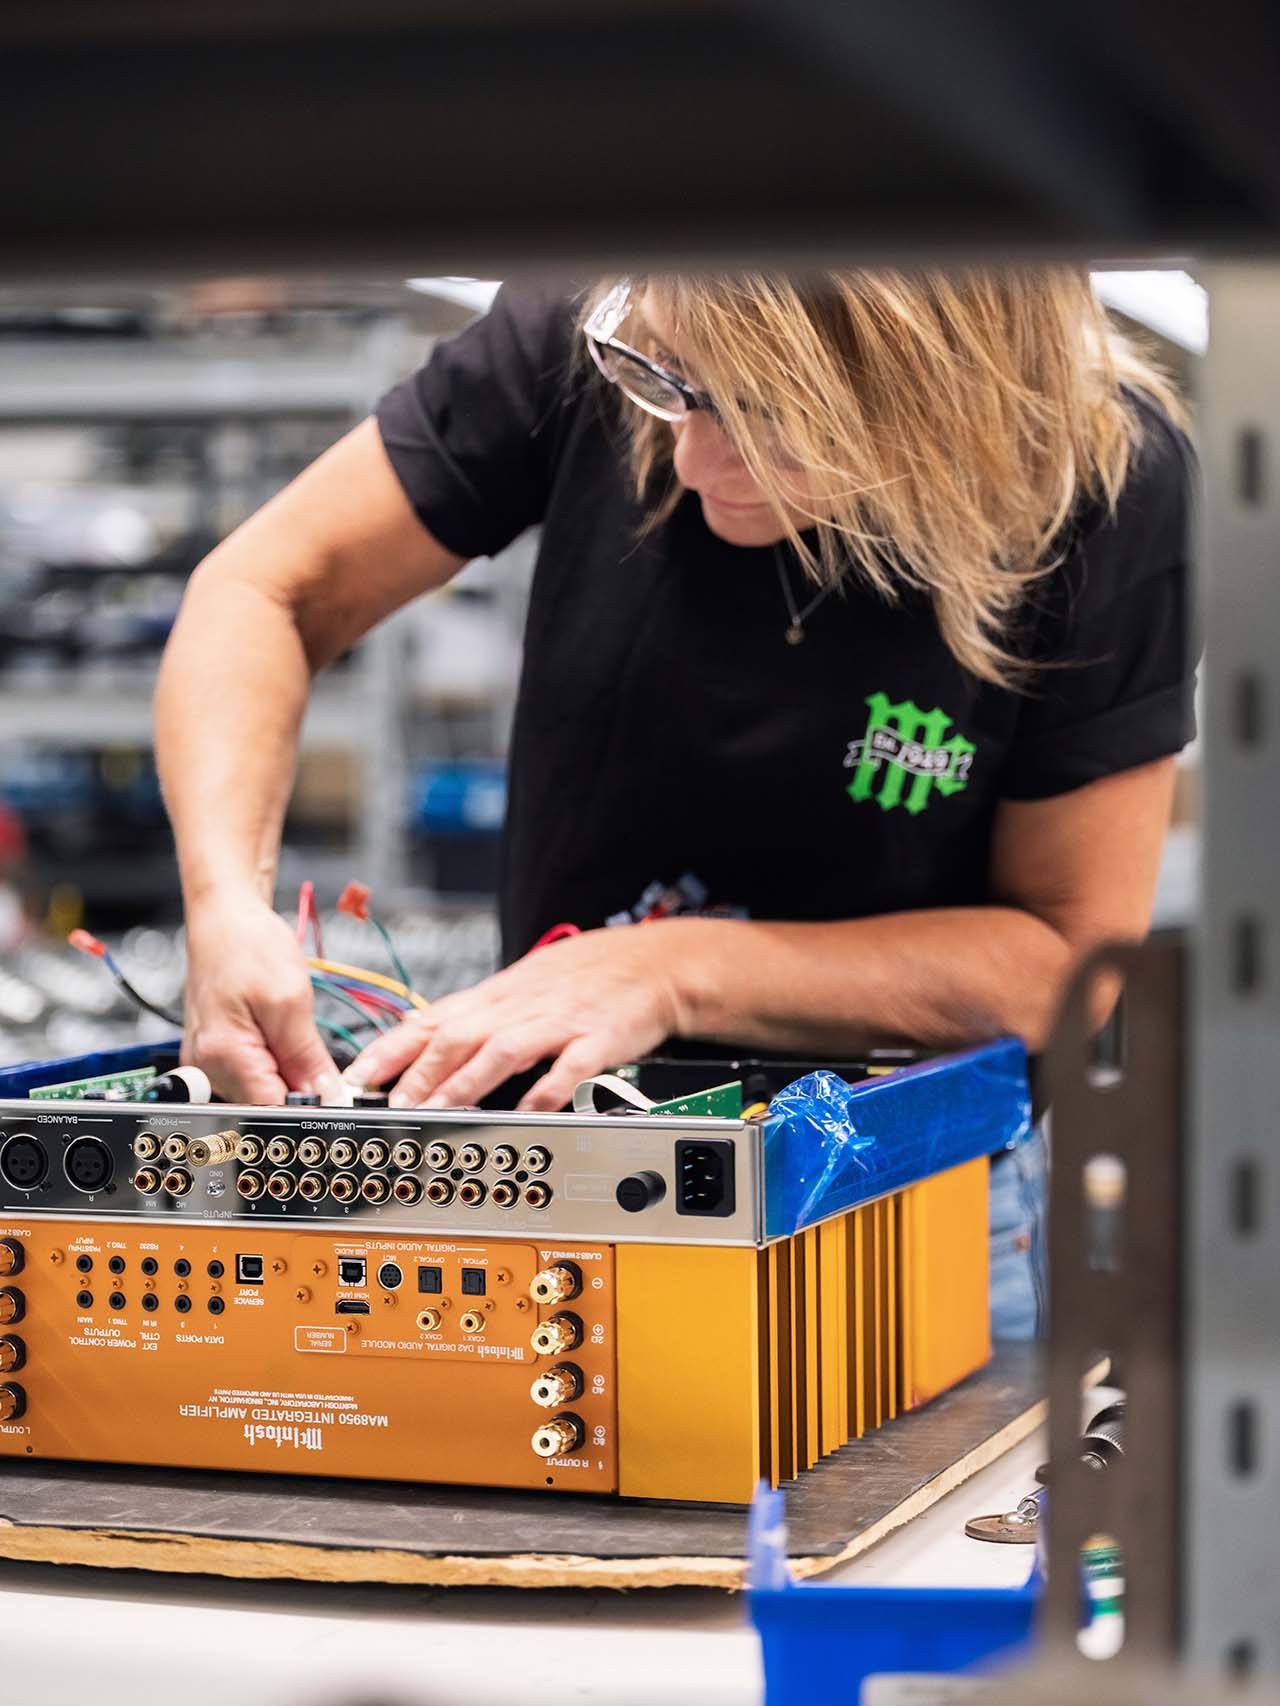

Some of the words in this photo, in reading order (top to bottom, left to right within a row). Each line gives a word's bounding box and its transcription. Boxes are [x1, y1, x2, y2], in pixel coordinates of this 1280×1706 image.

[37, 1115, 77, 1124] BALANCED
[149, 1117, 178, 1126] PHONO
[300, 1121, 356, 1131] UNBALANCED
[24, 1192, 30, 1200] L
[88, 1194, 94, 1202] R
[202, 1209, 232, 1219] INPUTS
[75, 1237, 94, 1245] INPUT
[111, 1241, 127, 1249] TRIG
[68, 1244, 101, 1253] PASSTHRU
[365, 1241, 395, 1251] INPUTS
[396, 1242, 422, 1251] AUDIO
[424, 1243, 456, 1252] DIGITAL
[334, 1247, 355, 1255] AUDIO
[382, 1254, 397, 1262] MCT
[418, 1255, 445, 1264] OPTICAL
[461, 1257, 489, 1265] OPTICAL
[238, 1288, 259, 1296] PORT
[233, 1297, 265, 1306] SERVICE
[77, 1316, 93, 1324] MAIN
[111, 1318, 128, 1326] TRIG
[83, 1327, 121, 1338] OUTPUTS
[139, 1331, 161, 1340] CTRL
[306, 1331, 335, 1340] NUMBER
[68, 1336, 106, 1346] CONTROL
[175, 1334, 203, 1343] PORTS
[204, 1335, 225, 1344] DATA
[107, 1338, 137, 1349] POWER
[142, 1343, 158, 1351] EXT
[361, 1339, 396, 1349] MODULE
[396, 1341, 422, 1350] AUDIO
[425, 1342, 457, 1352] DIGITAL
[457, 1344, 475, 1353] DA2
[477, 1345, 524, 1361] McIntosh
[213, 1388, 232, 1396] PARTS
[207, 1395, 217, 1403] NY
[314, 1393, 354, 1402] HANDCRAFTED
[178, 1404, 248, 1420] AMPLIFIER
[252, 1408, 334, 1425] INTEGRATED
[338, 1412, 389, 1427] MA8950
[25, 1426, 31, 1435] L
[243, 1423, 323, 1451] McIntosh
[546, 1457, 581, 1467] OUTPUT
[582, 1459, 589, 1468] R
